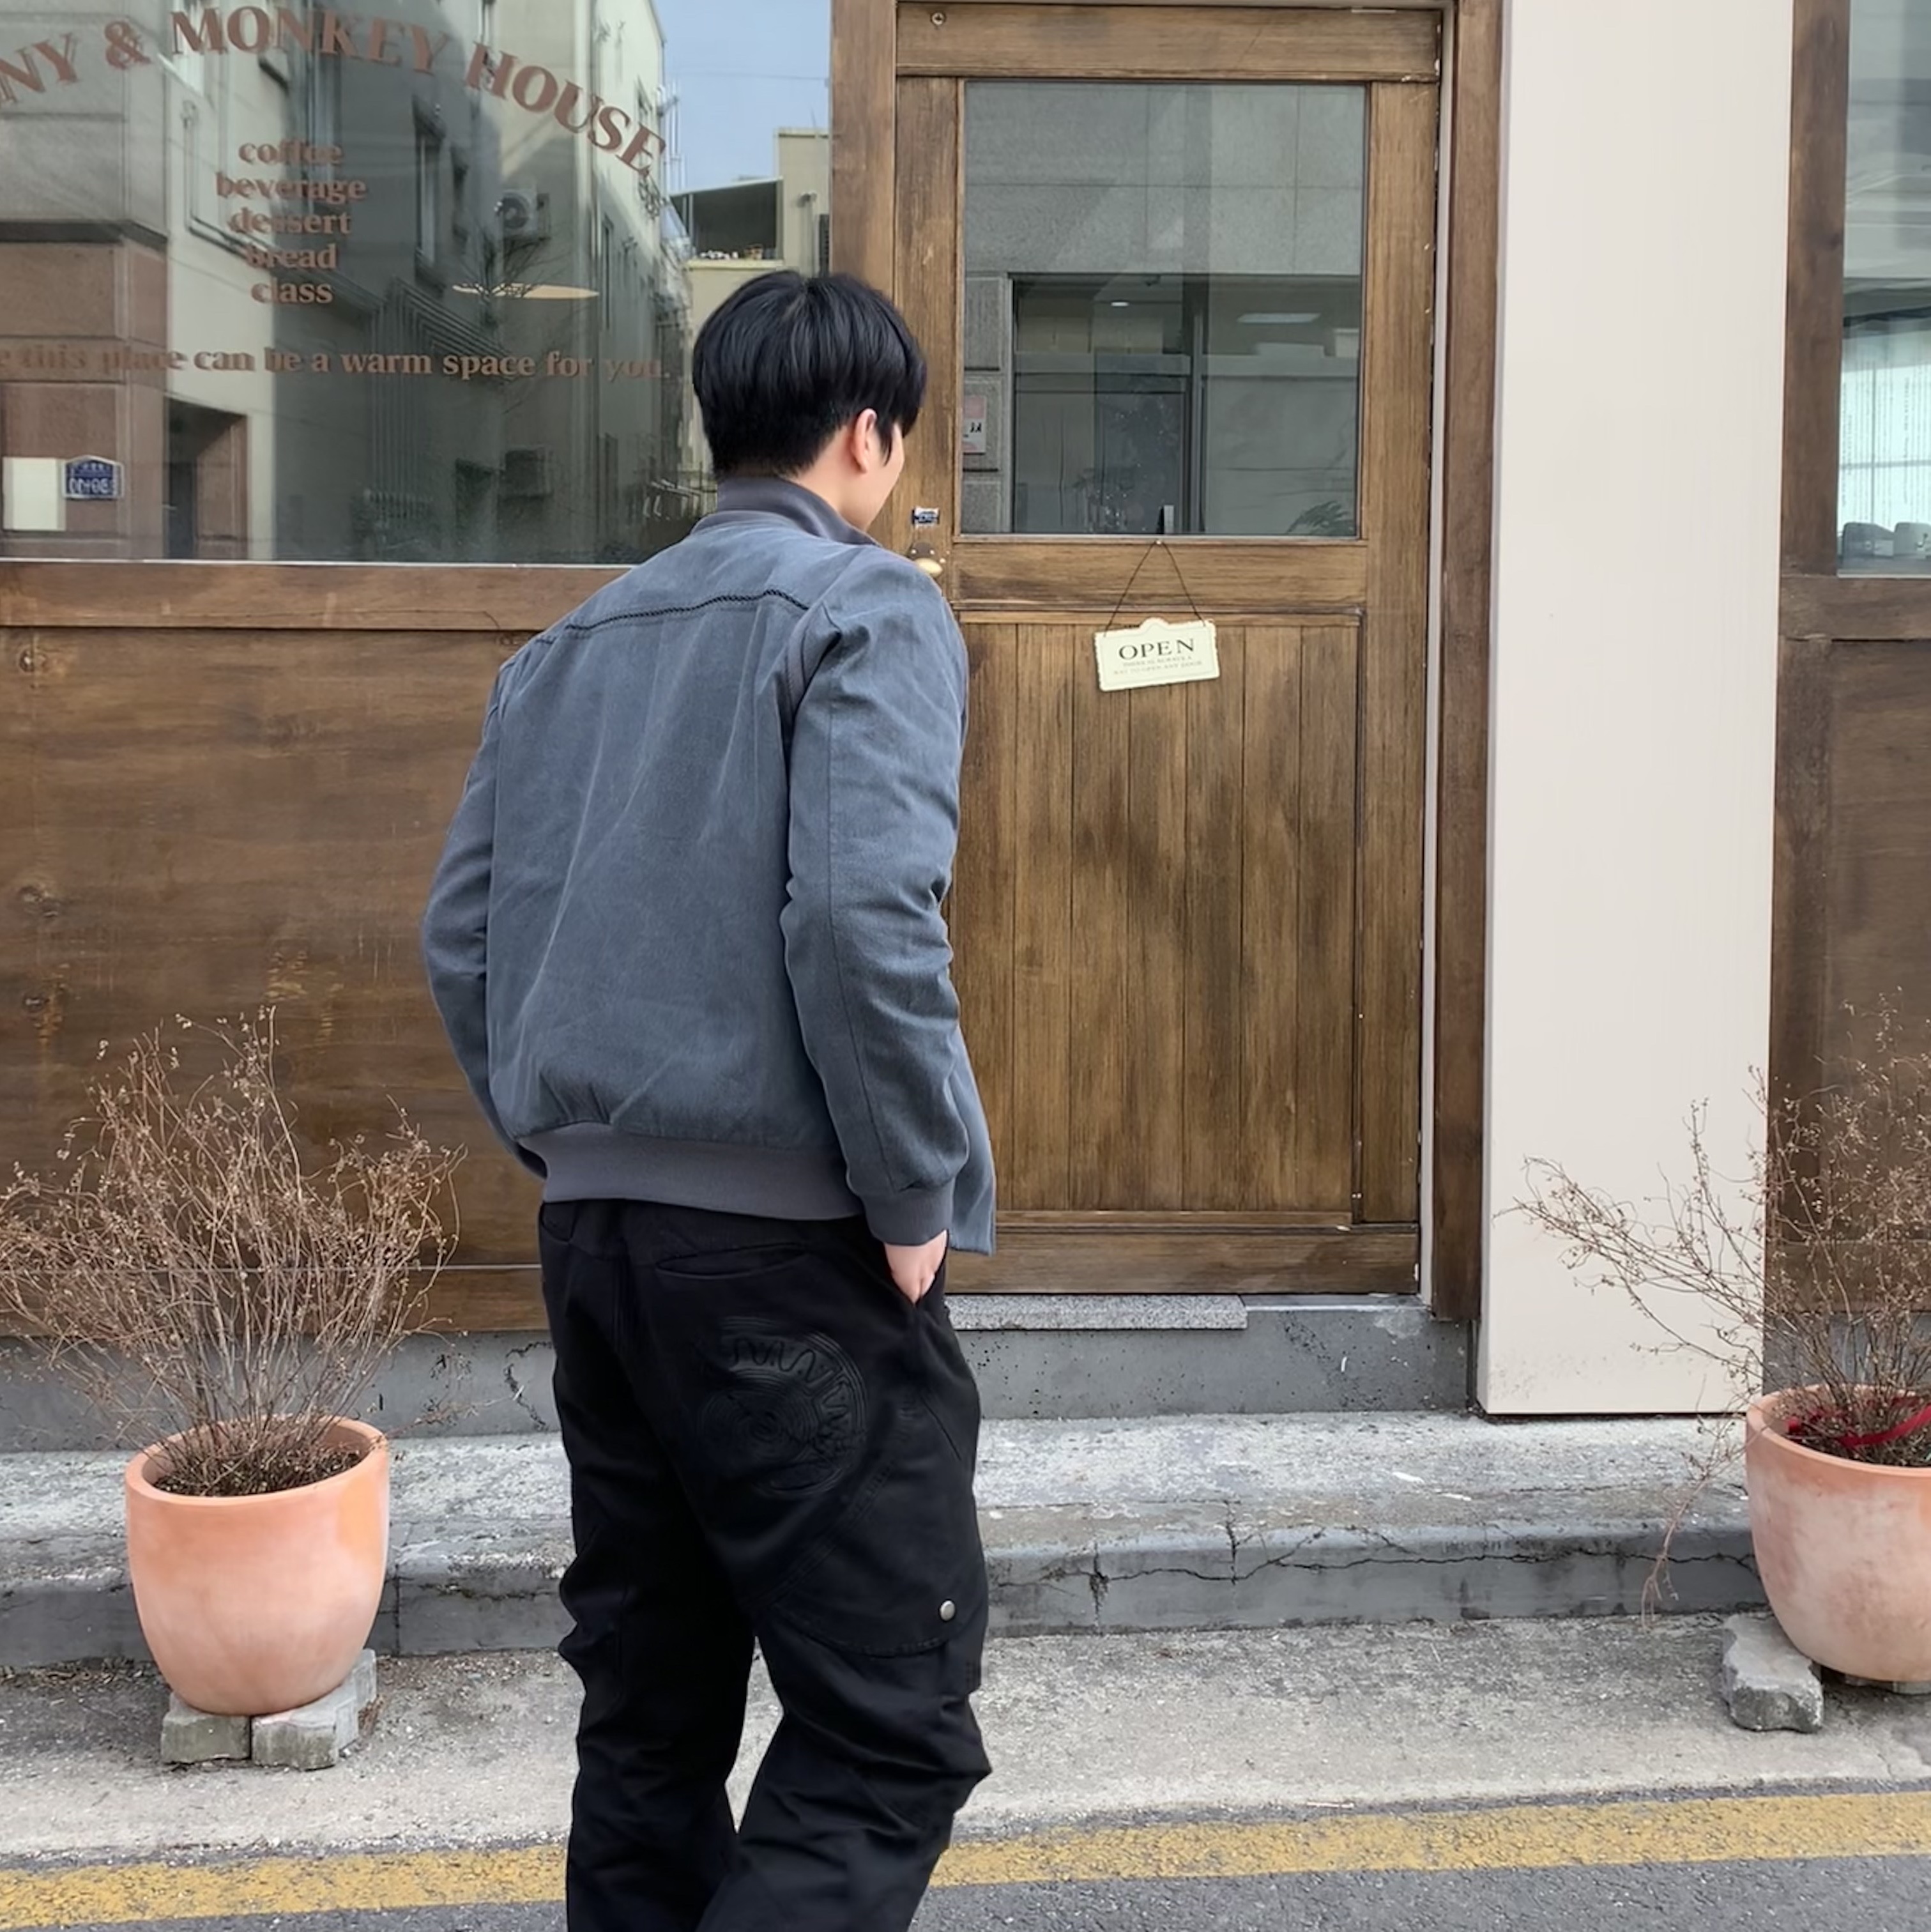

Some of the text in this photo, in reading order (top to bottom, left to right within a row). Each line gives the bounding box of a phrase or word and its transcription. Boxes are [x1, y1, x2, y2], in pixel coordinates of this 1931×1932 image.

[103, 20, 152, 70] &
[170, 5, 450, 75] MONKEY
[465, 40, 666, 178] HOUSE
[238, 138, 343, 165] coffee
[215, 171, 368, 205] beverage
[227, 206, 351, 234] dessert
[242, 242, 339, 270] bread
[250, 277, 334, 303] class
[22, 343, 87, 370] this
[102, 344, 188, 375] place
[193, 351, 256, 371] can
[263, 346, 302, 374] be
[311, 352, 332, 374] a
[340, 353, 432, 374] warm
[442, 354, 537, 381] space
[546, 351, 593, 377] for
[1118, 638, 1193, 660] OPEN
